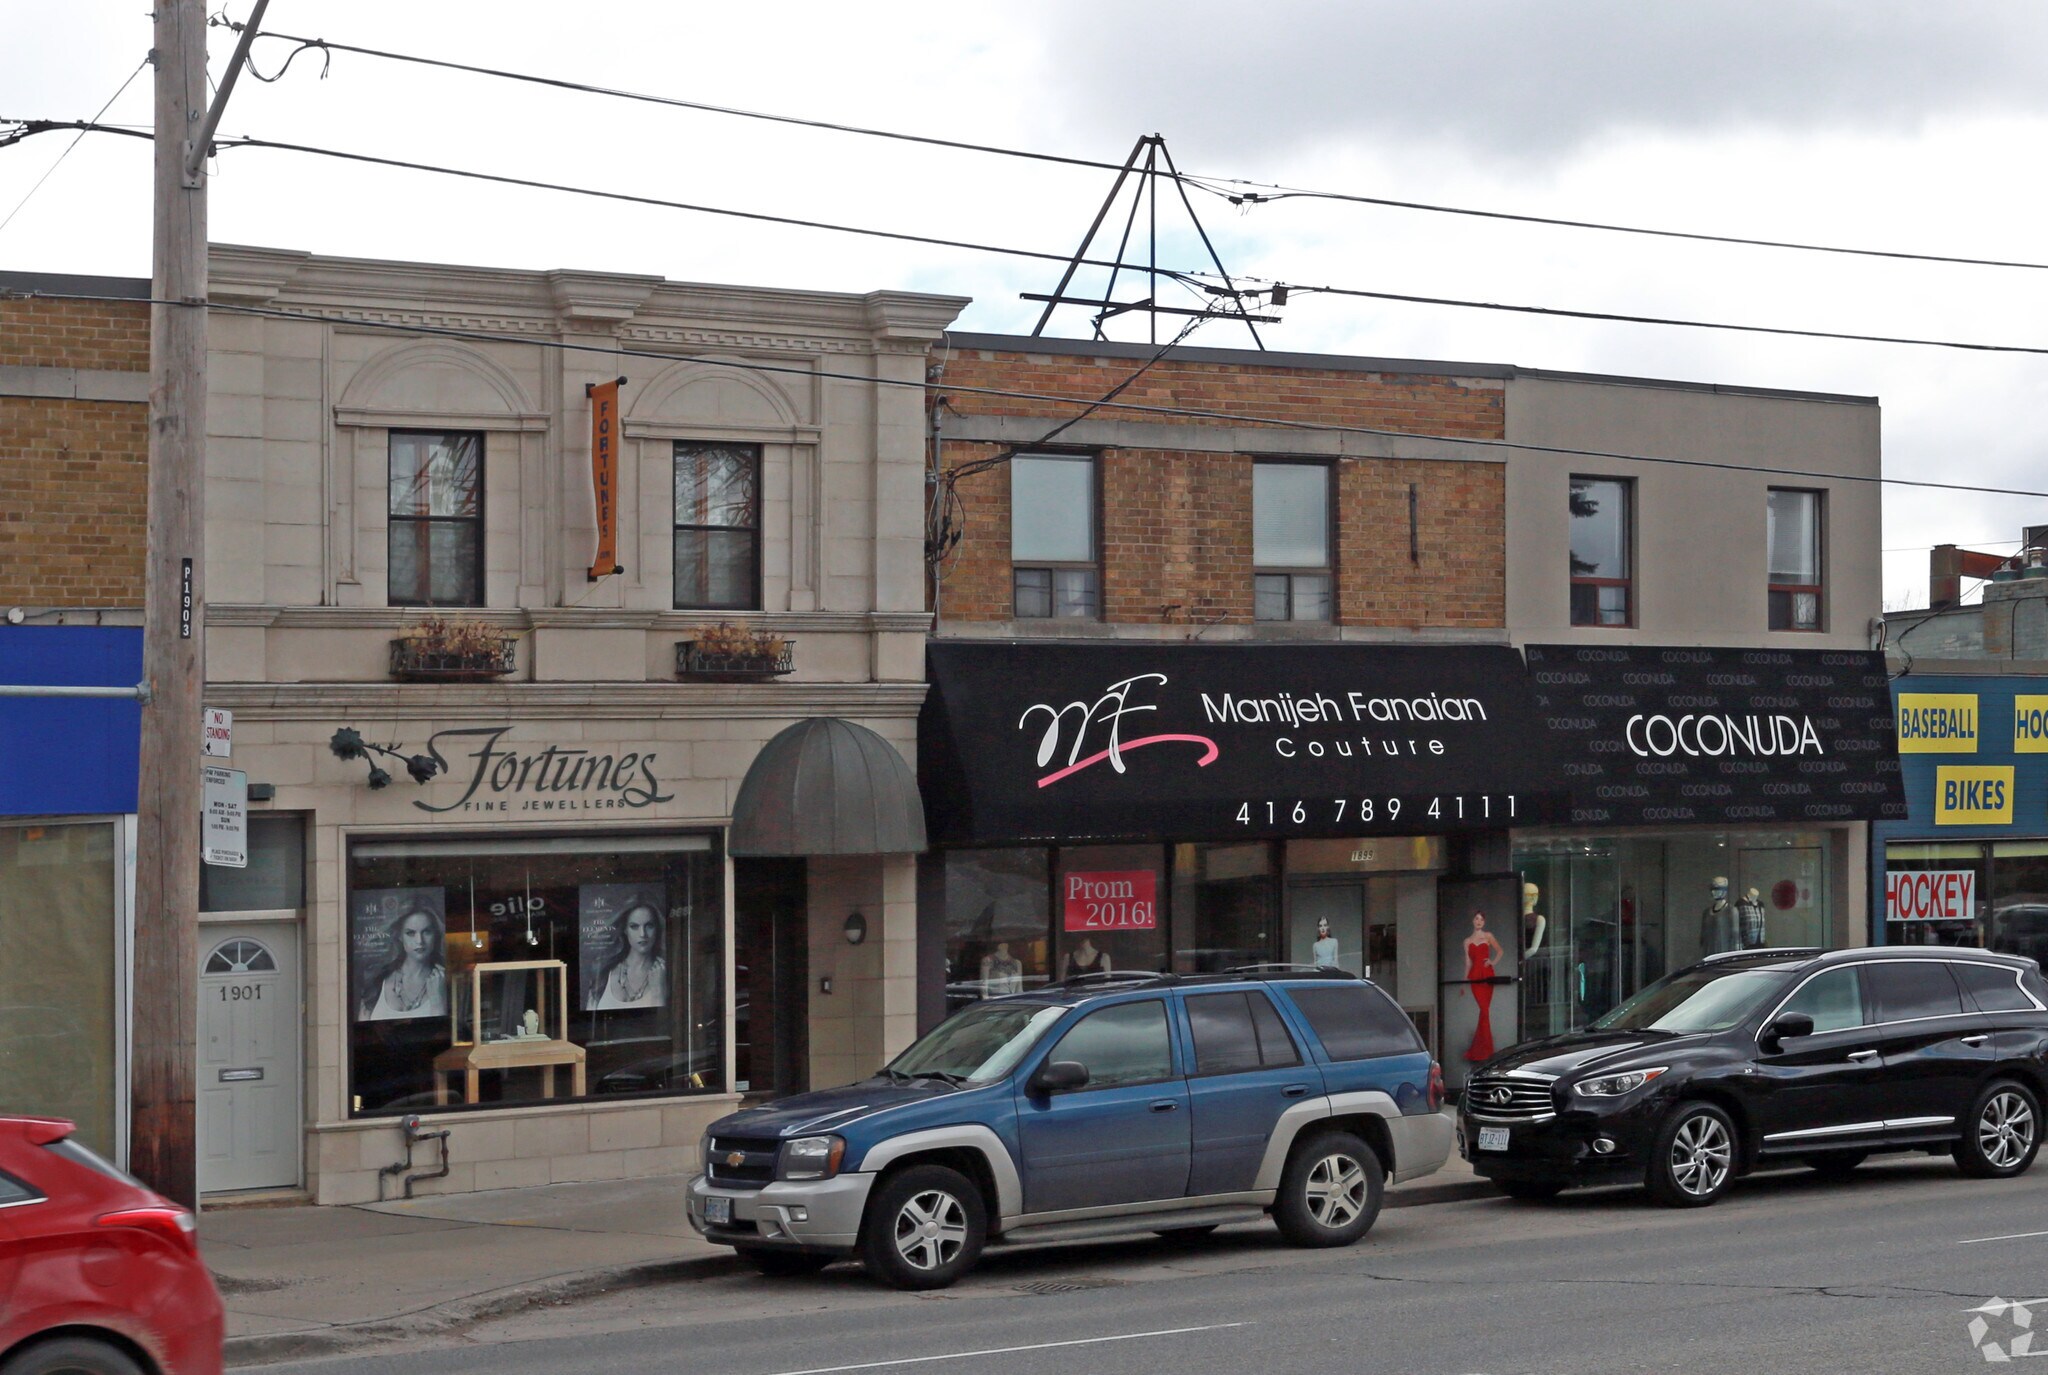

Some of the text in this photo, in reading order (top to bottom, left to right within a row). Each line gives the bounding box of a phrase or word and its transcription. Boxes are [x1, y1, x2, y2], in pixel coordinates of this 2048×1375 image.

[598, 401, 609, 538] FORTUNES
[183, 567, 191, 636] P1903
[213, 712, 223, 725] NO
[1200, 692, 1487, 728] Manijeh Fanaian
[1901, 708, 1975, 739] BASEBALL
[206, 727, 231, 741] STANDING
[1275, 737, 1445, 758] Couture
[1626, 713, 1824, 757] COCONUDA
[412, 726, 675, 812] Fortunes
[464, 798, 626, 812] FINE JEWELLERS
[1944, 780, 2005, 811] BIKES
[1236, 796, 1517, 825] 416 789 4111
[1351, 850, 1374, 861] 1899
[1068, 876, 1134, 900] Prom
[1886, 873, 1973, 920] HOCKEY
[1085, 901, 1153, 926] 2016!
[219, 984, 262, 1001] 1901
